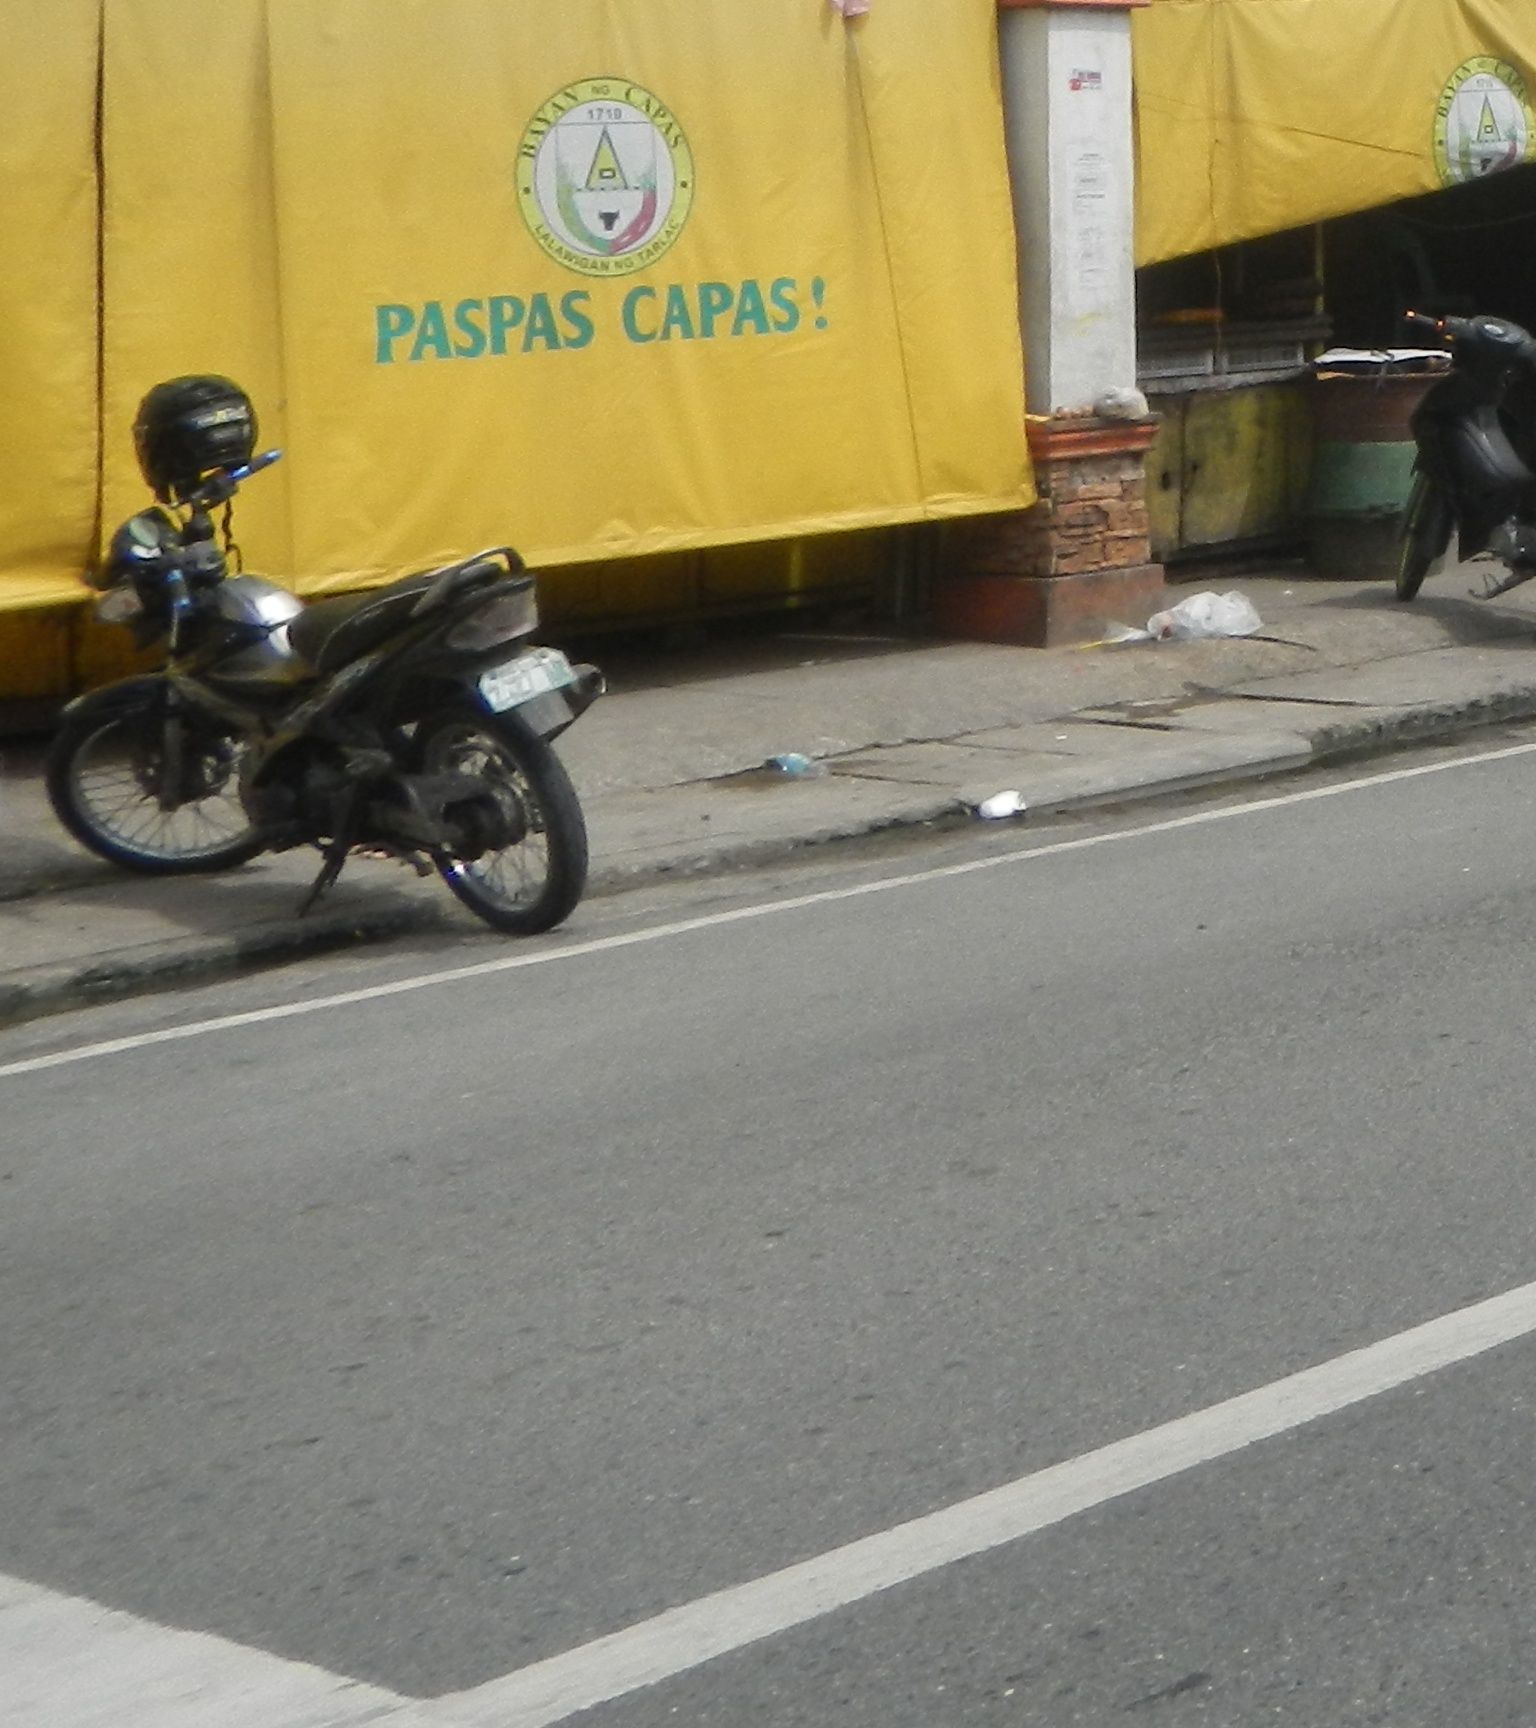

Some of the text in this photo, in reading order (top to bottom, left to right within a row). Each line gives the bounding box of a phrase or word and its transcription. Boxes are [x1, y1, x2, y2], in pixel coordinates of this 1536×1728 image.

[522, 89, 579, 158] BAYAN
[624, 86, 683, 150] CAPAS
[375, 276, 829, 364] PASPAS CAPAS!
